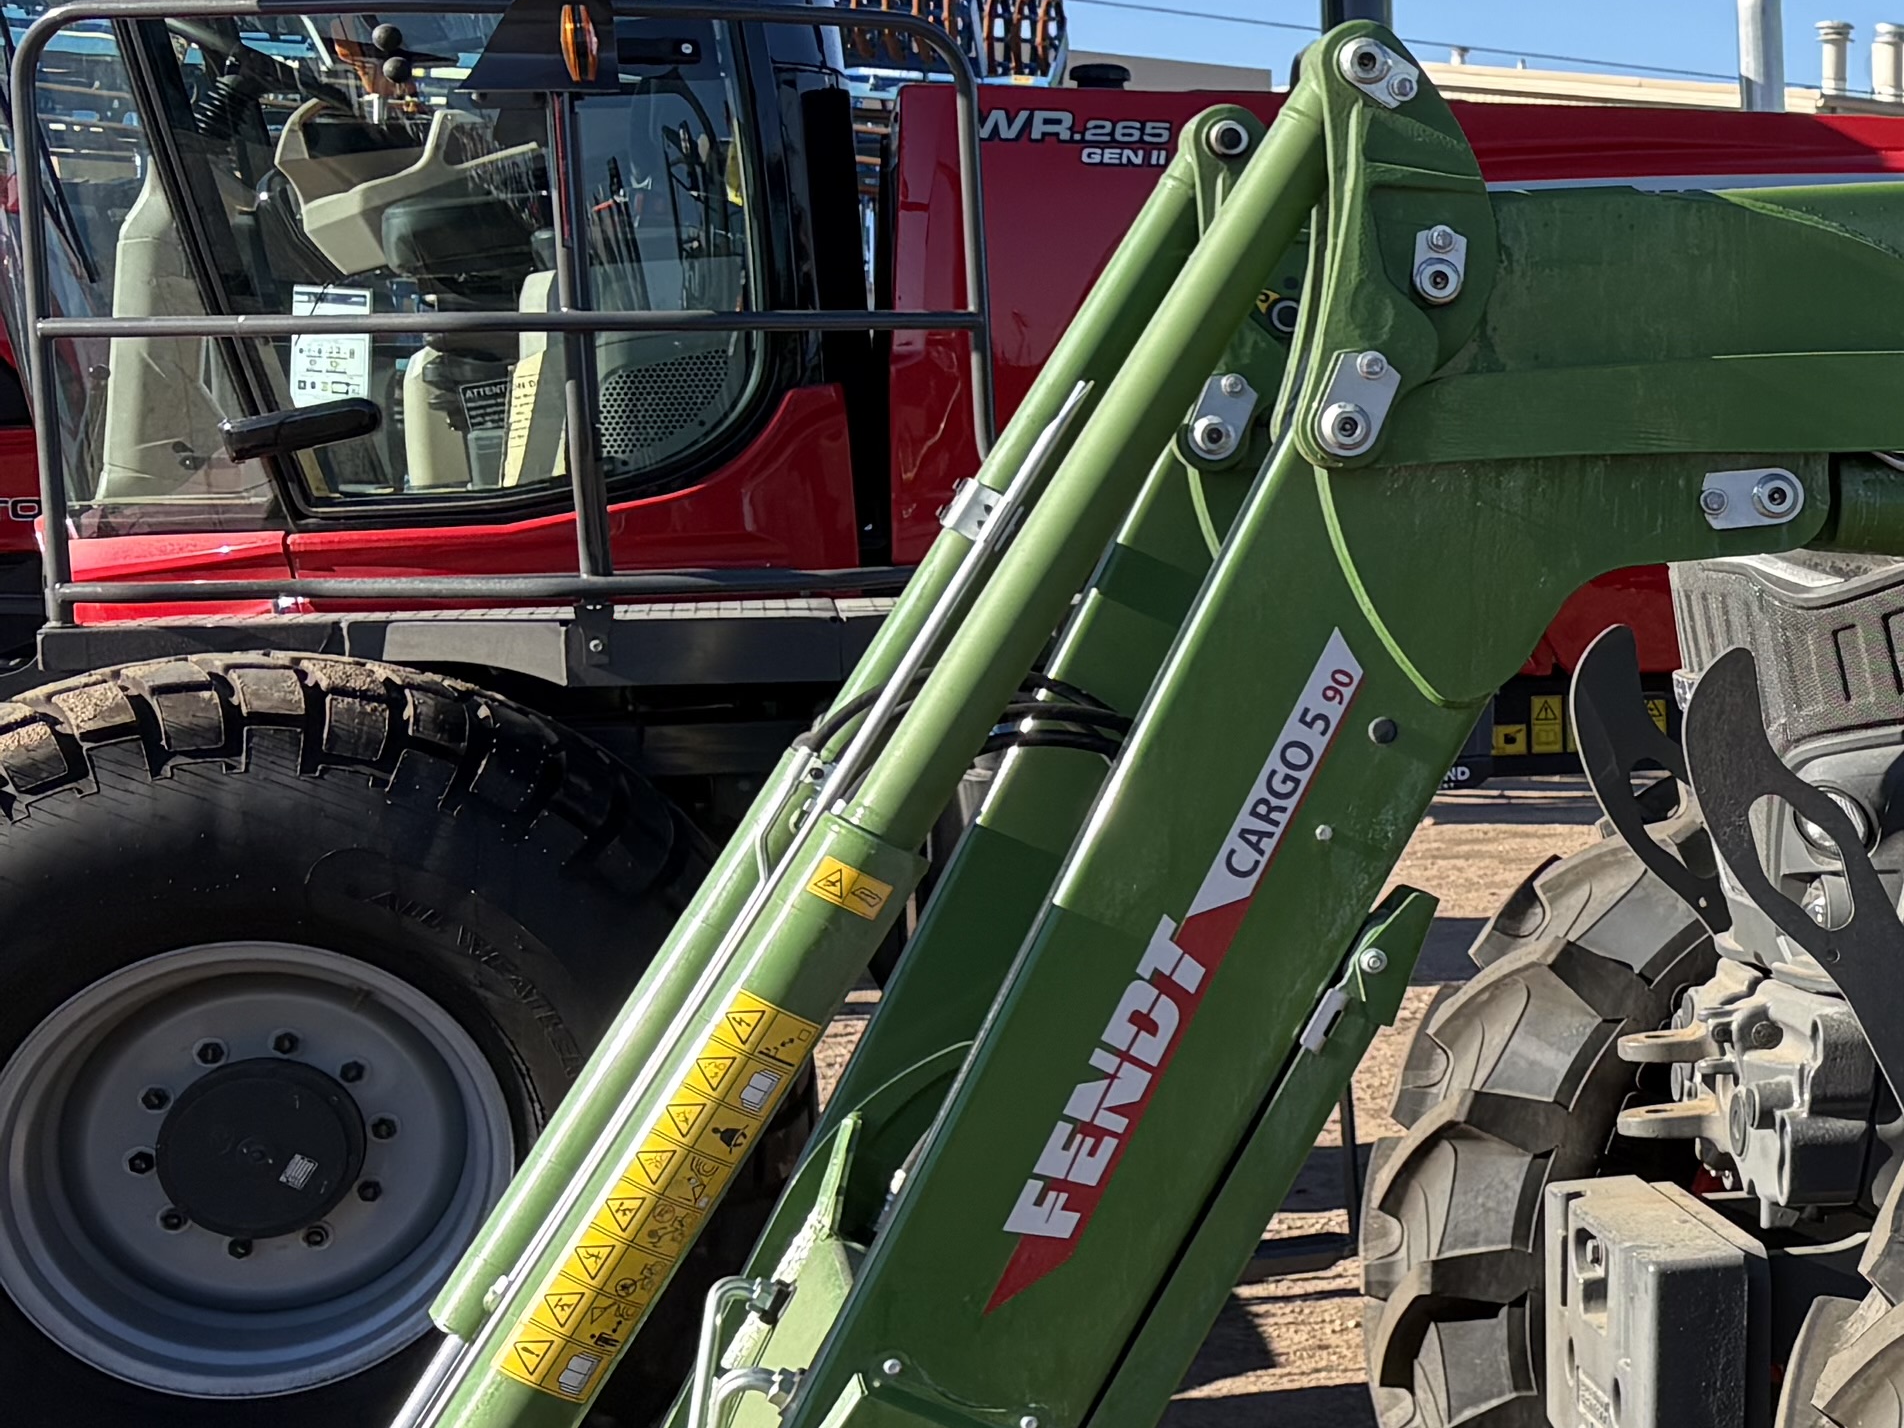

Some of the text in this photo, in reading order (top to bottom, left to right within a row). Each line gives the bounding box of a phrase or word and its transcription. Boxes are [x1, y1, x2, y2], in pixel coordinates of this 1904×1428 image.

[980, 110, 1170, 143] WR.265
[1081, 148, 1166, 164] GEN II
[1225, 740, 1314, 879] CARGO
[1003, 914, 1206, 1239] FENDT
